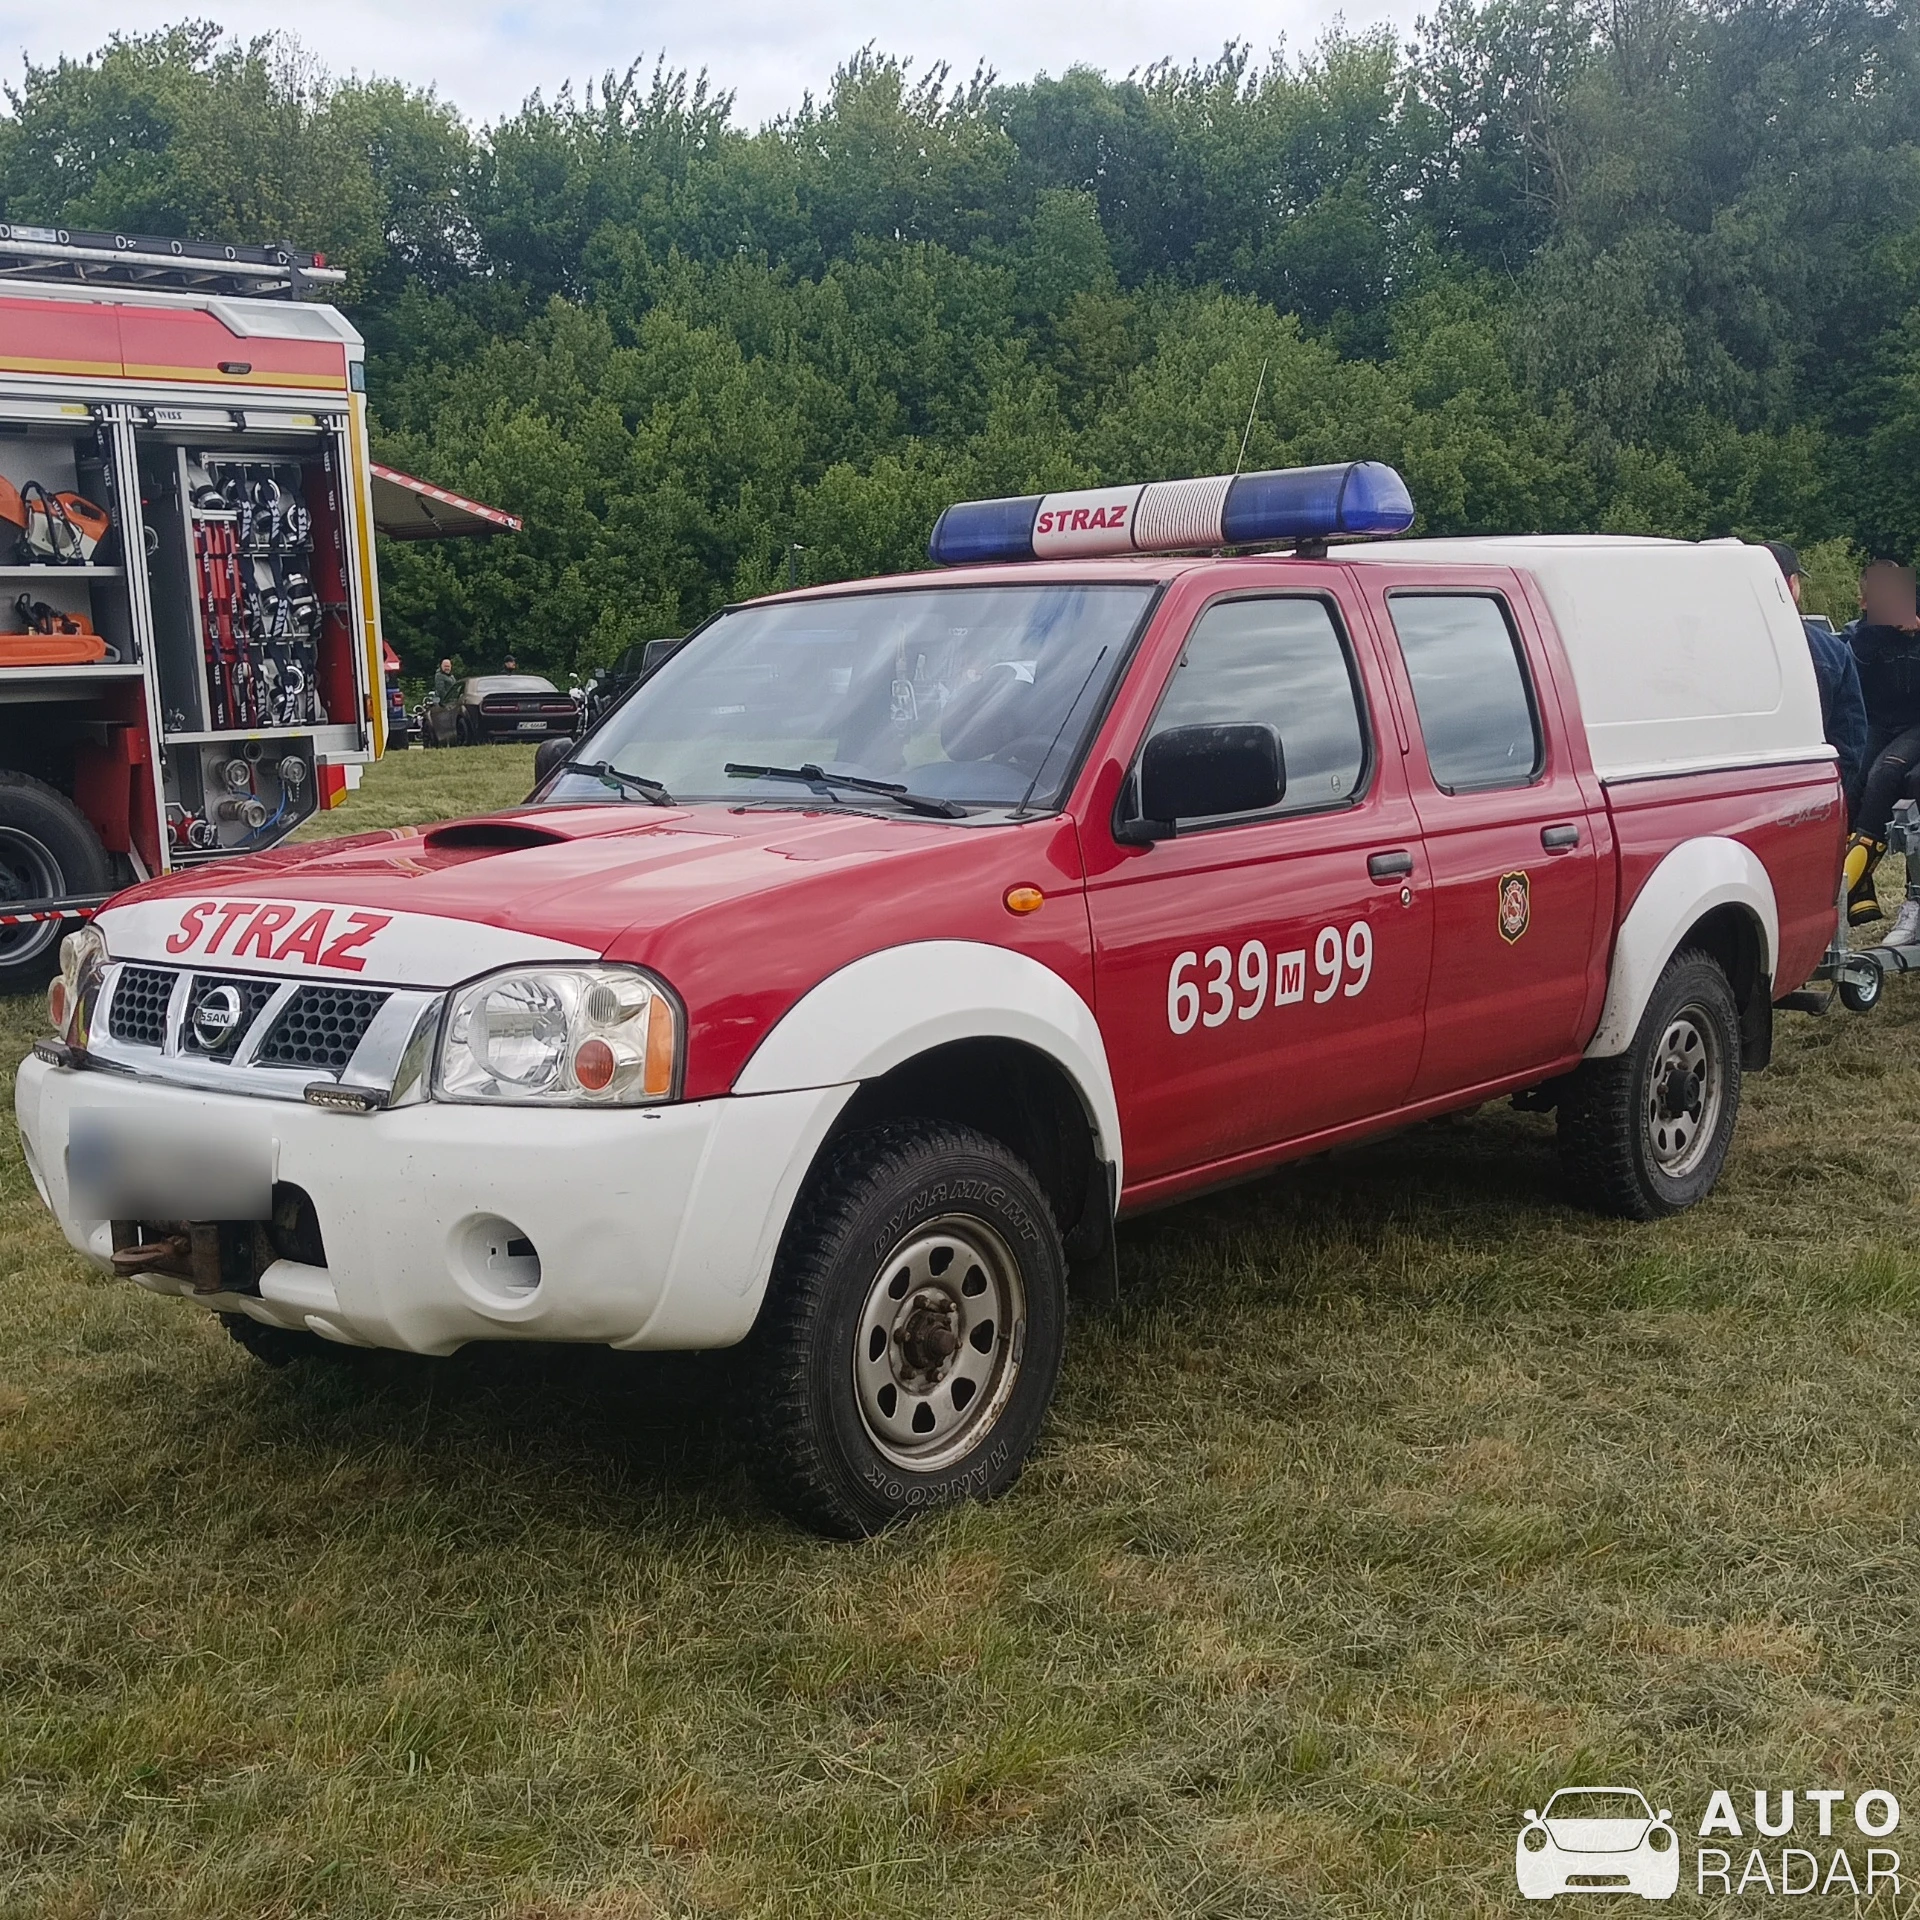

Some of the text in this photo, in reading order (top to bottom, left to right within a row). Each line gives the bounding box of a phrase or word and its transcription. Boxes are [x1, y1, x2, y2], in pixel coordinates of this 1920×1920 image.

[157, 411, 182, 420] WISS
[241, 500, 252, 540] WISS
[268, 499, 281, 540] WISS
[296, 507, 307, 545] WISS
[272, 599, 288, 637] WISS
[256, 681, 266, 718] WISS
[281, 684, 295, 722] WISS
[1167, 939, 1269, 1035] 639
[1313, 920, 1373, 1004] 99
[872, 1179, 1041, 1260] DYNAMIC MT
[863, 1439, 1009, 1506] HANKOOK
